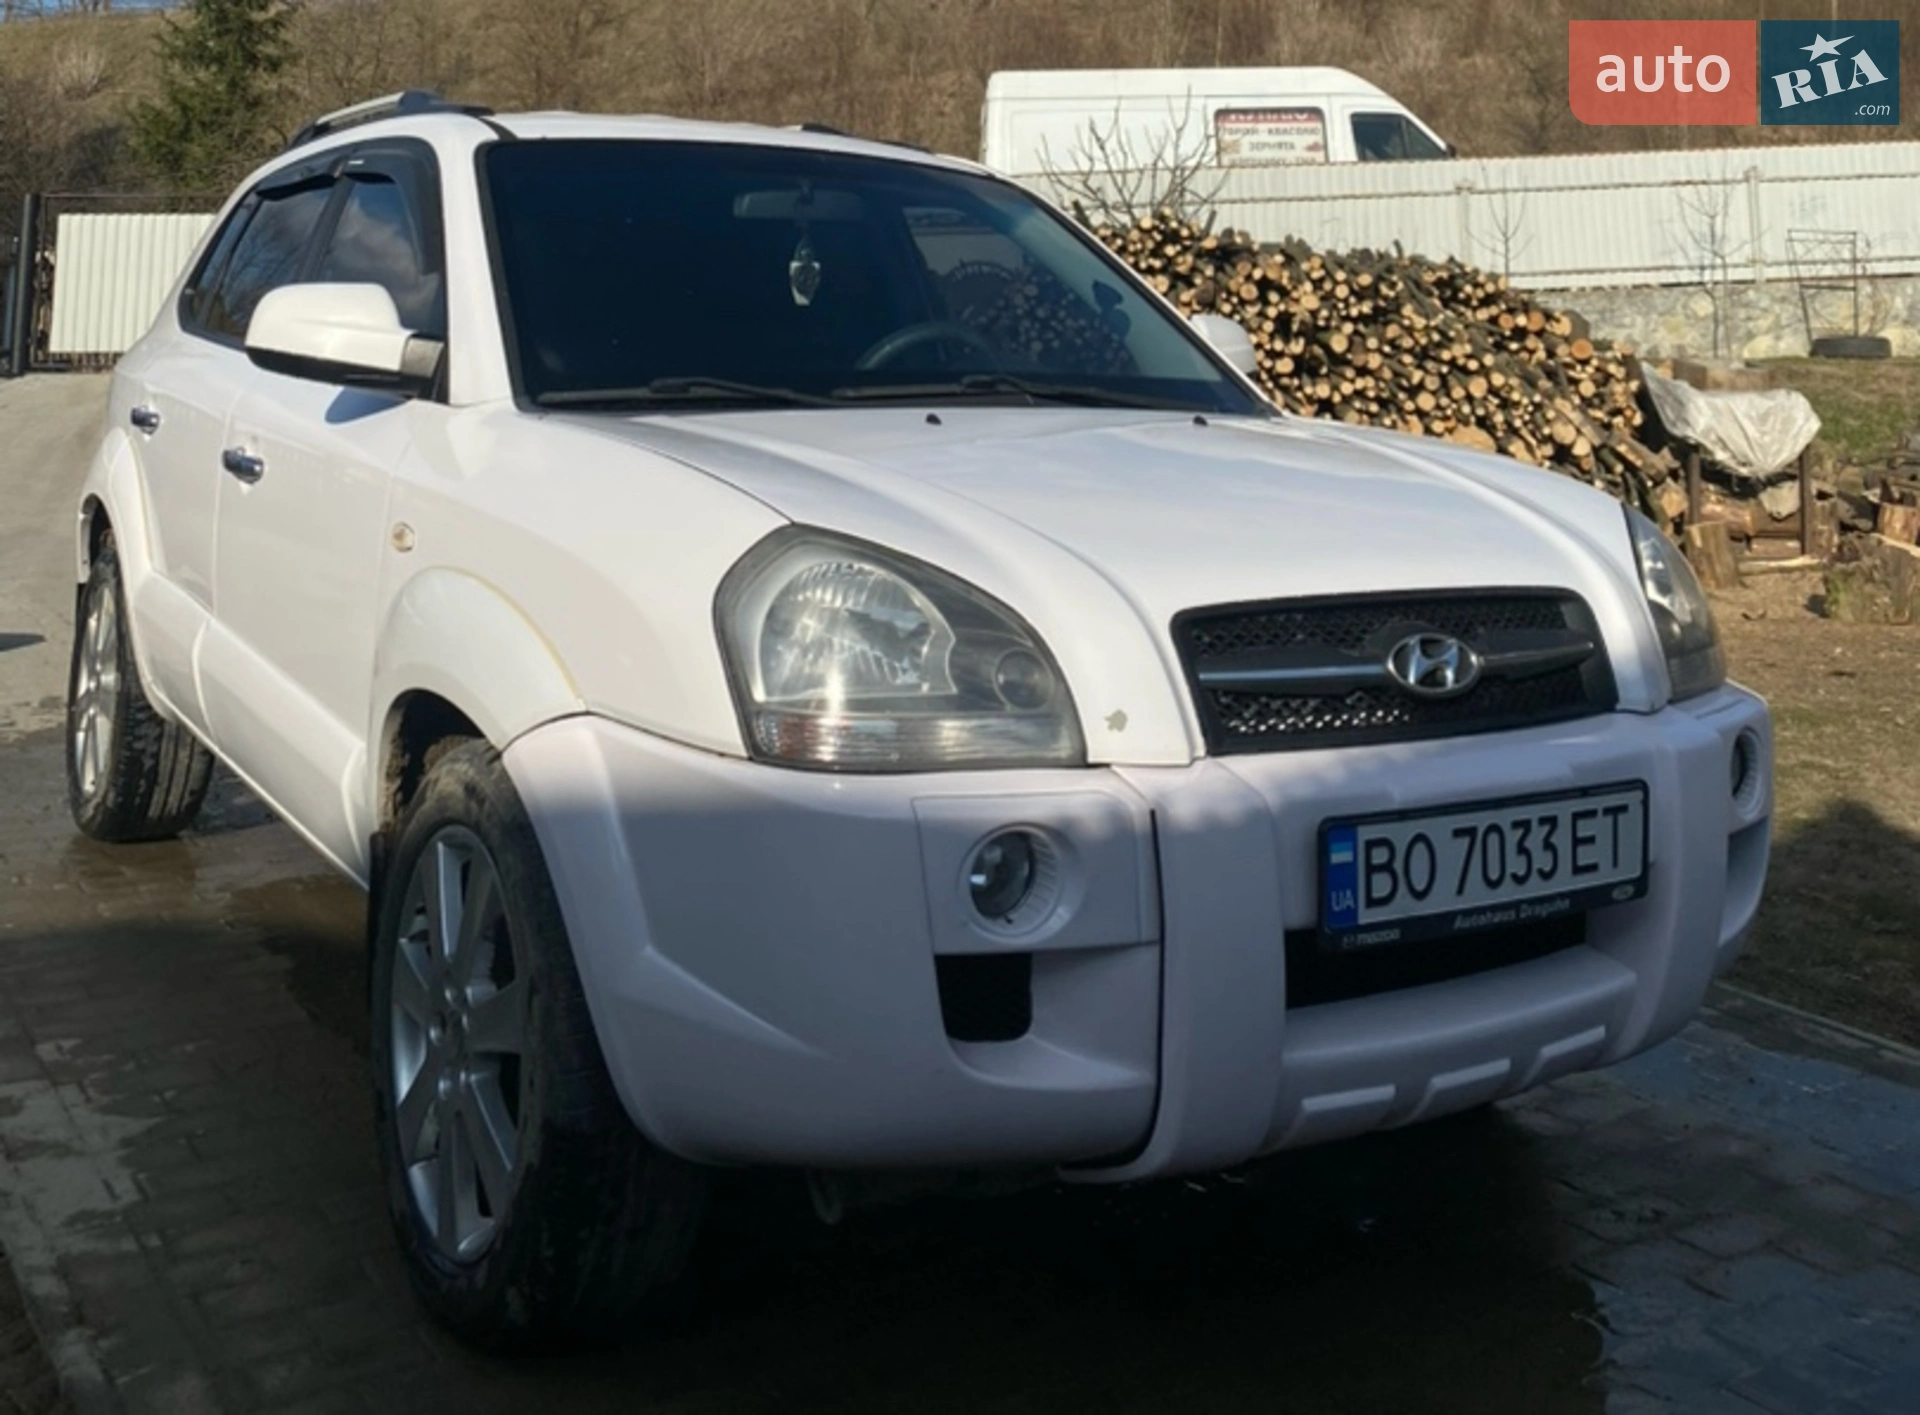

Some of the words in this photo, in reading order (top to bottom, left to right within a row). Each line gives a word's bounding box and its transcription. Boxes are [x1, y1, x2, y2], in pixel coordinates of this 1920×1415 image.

[1365, 833, 1437, 909] BO
[1453, 815, 1558, 896] 7033
[1570, 803, 1630, 876] ET
[1331, 888, 1355, 912] UA
